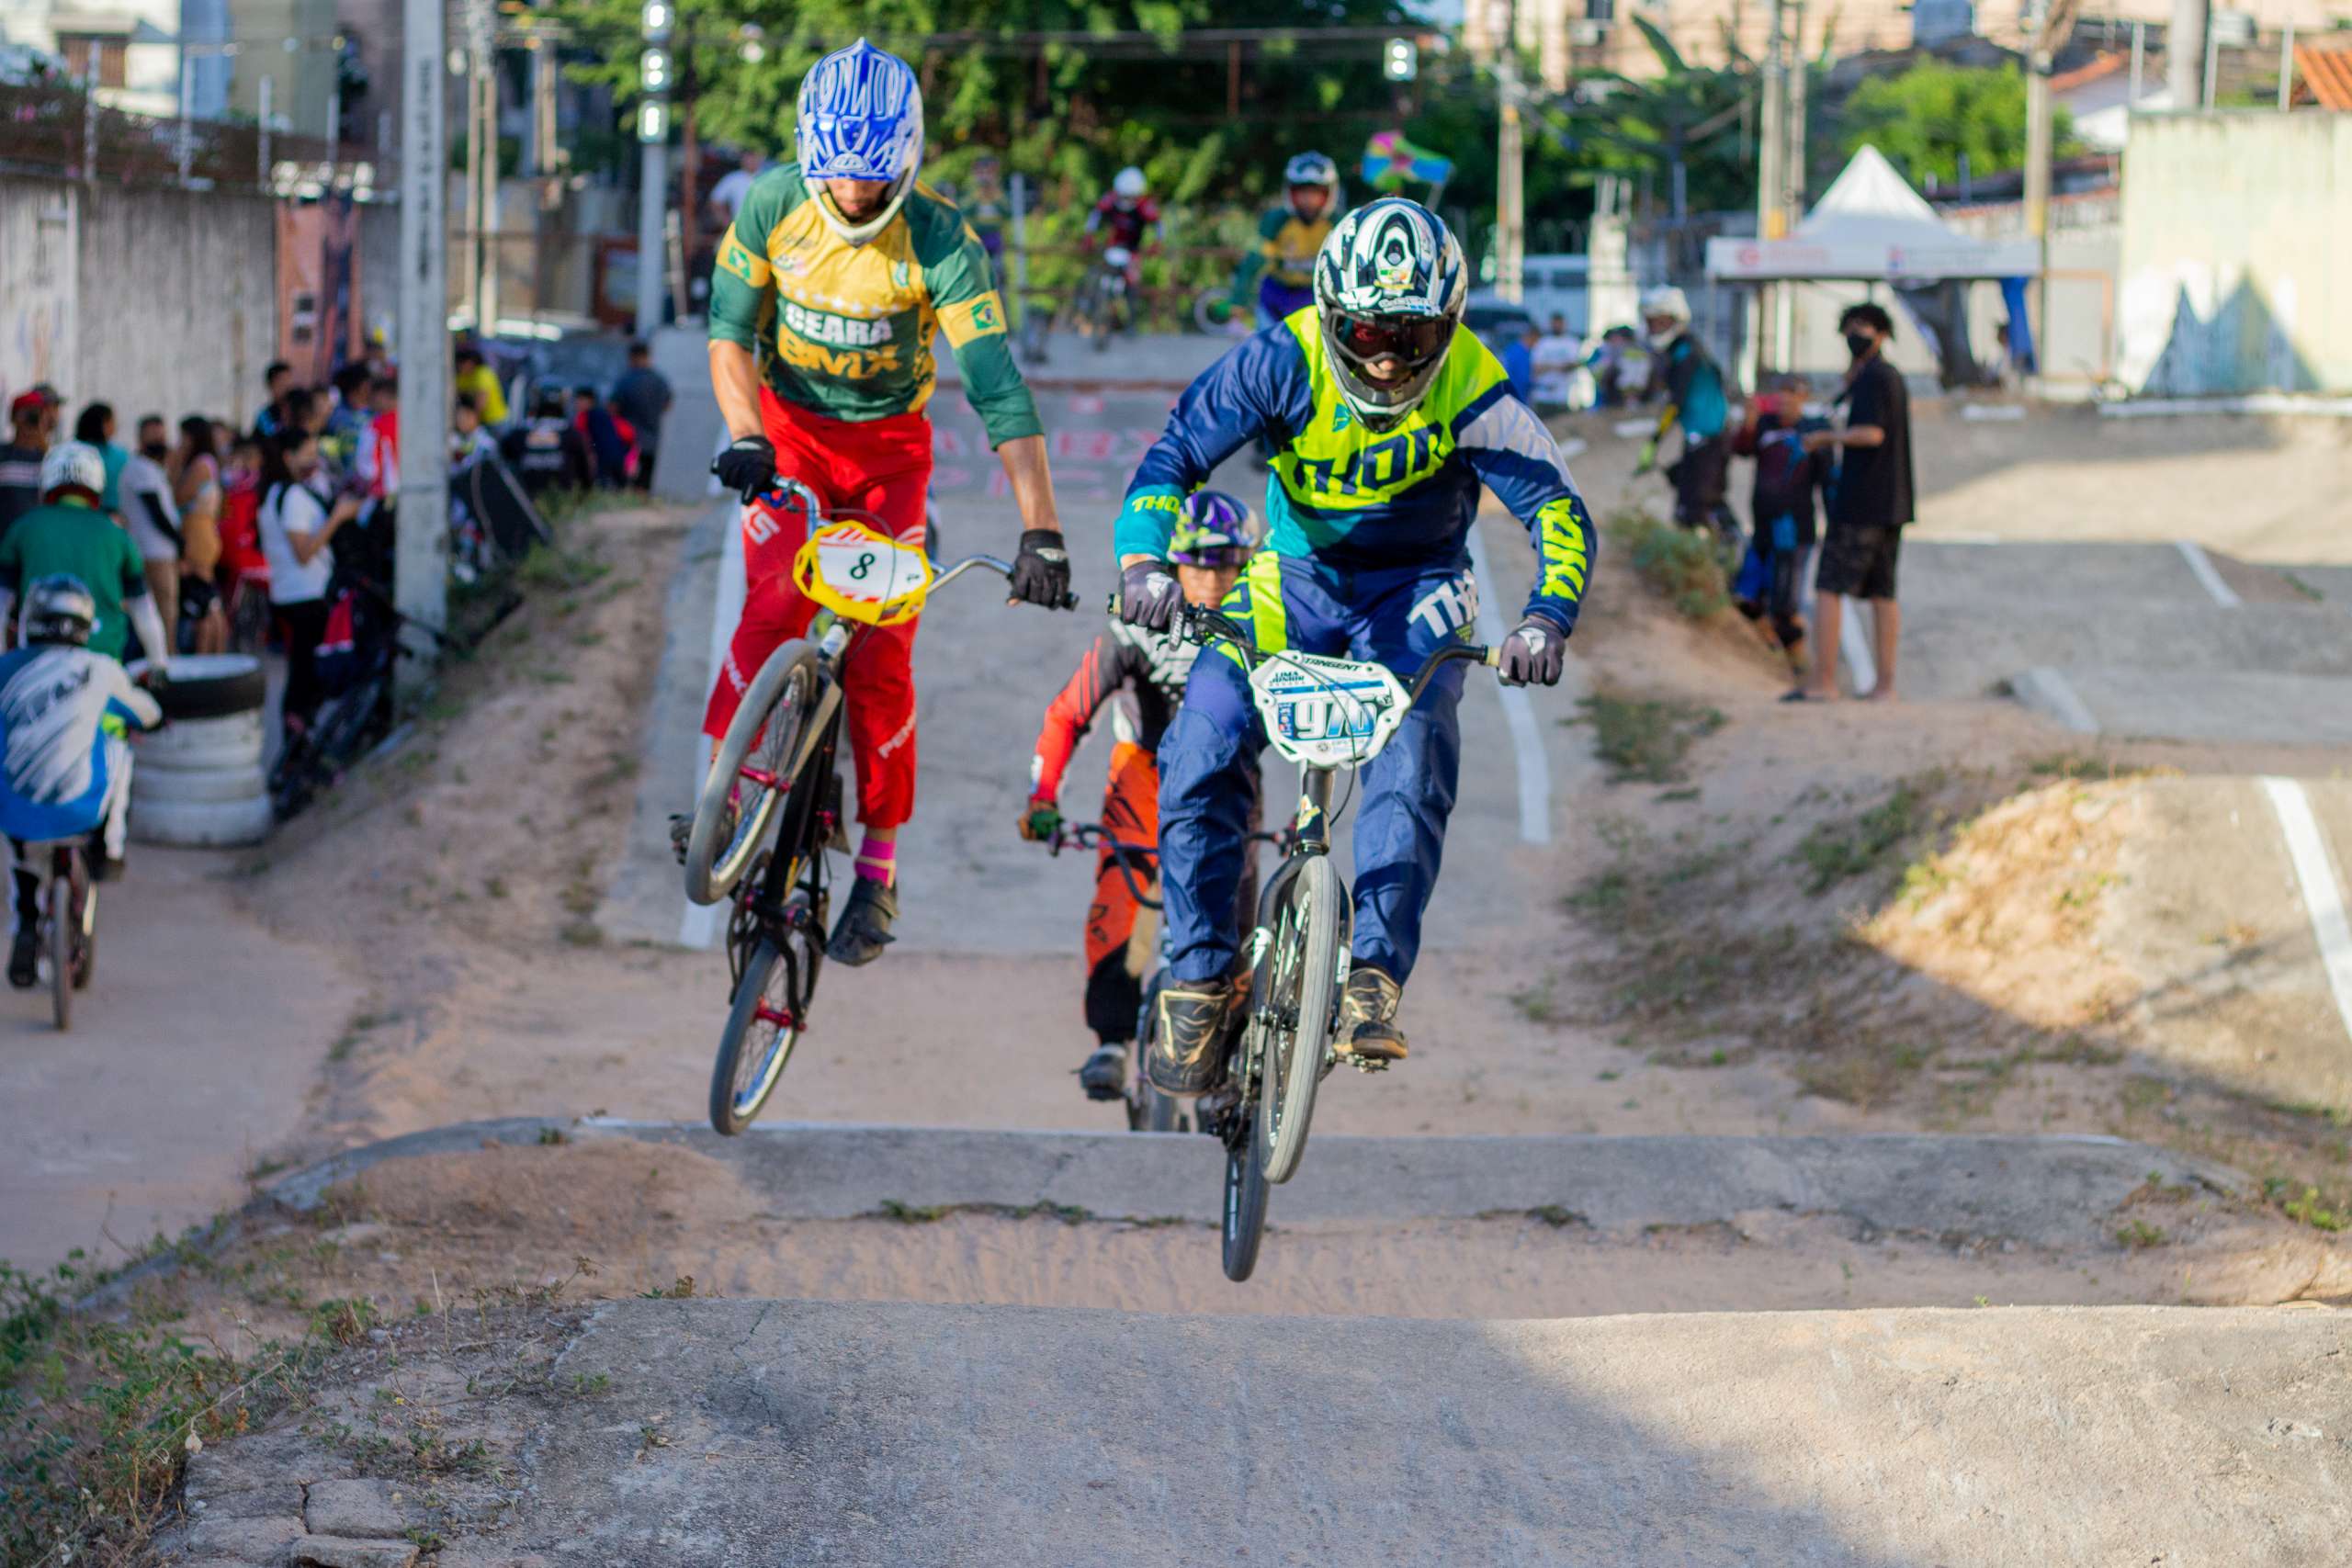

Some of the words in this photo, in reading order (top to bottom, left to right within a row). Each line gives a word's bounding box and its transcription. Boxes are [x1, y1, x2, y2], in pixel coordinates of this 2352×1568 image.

[778, 322, 902, 380] BMX
[1132, 494, 1181, 517] THO
[849, 552, 876, 581] 8
[1304, 656, 1363, 672] TANGENT
